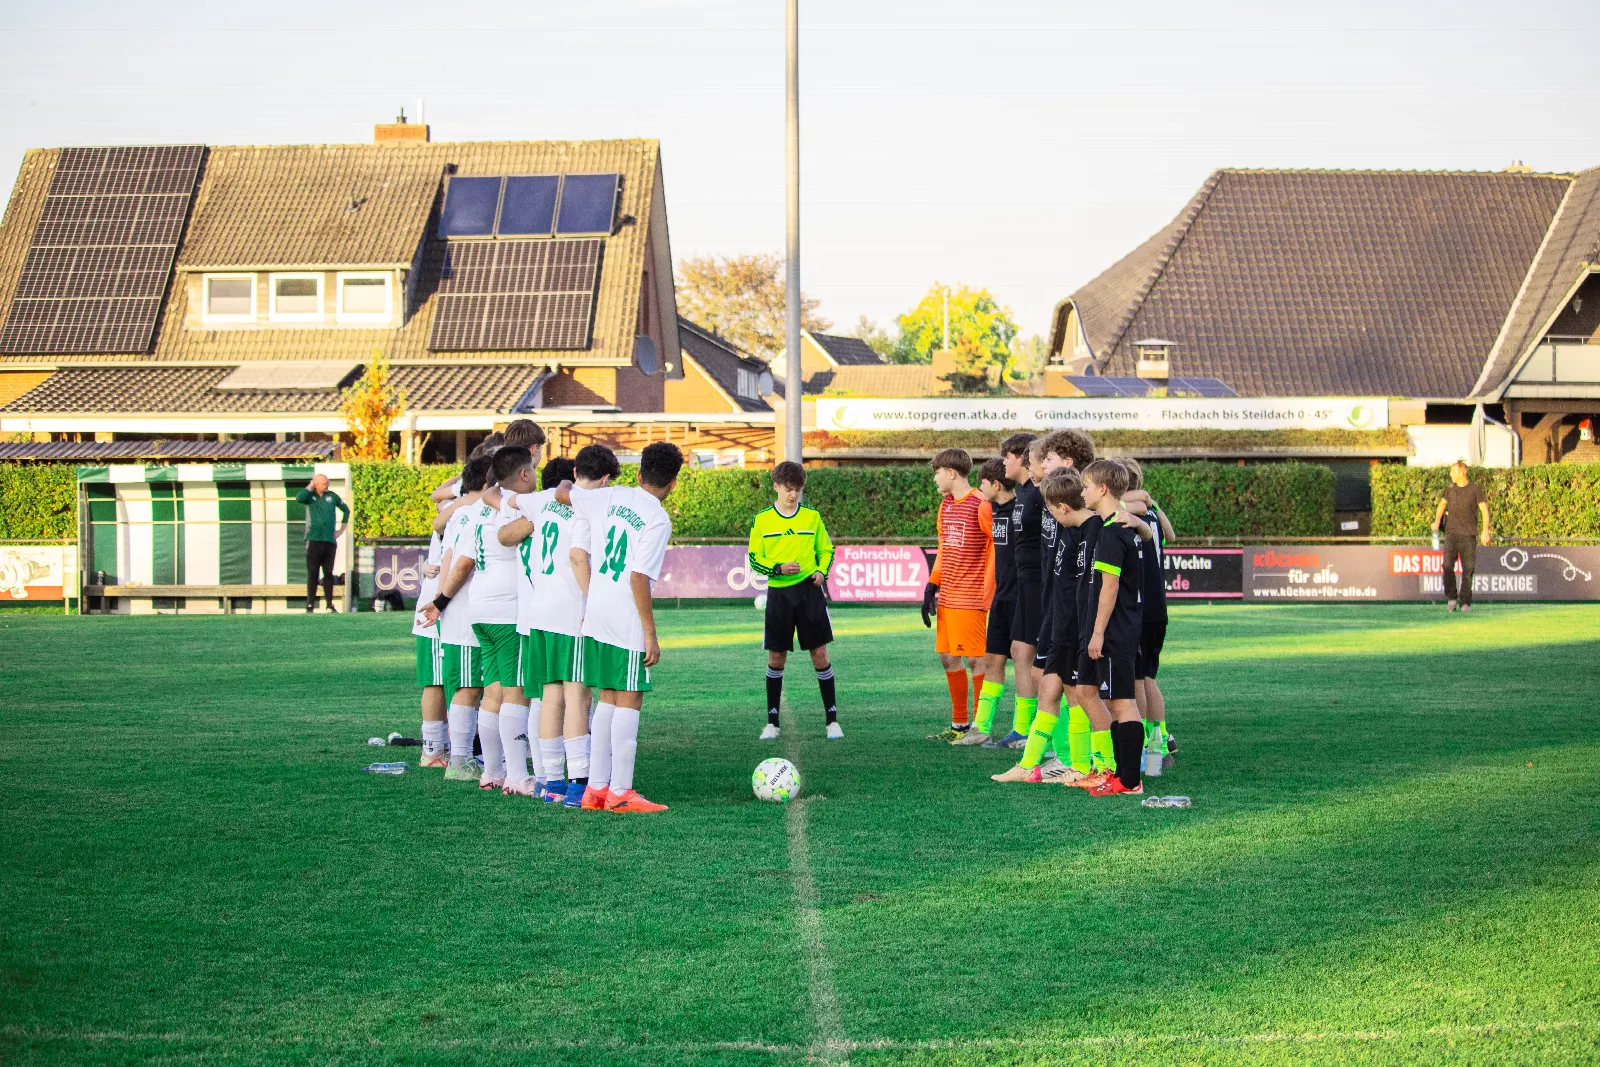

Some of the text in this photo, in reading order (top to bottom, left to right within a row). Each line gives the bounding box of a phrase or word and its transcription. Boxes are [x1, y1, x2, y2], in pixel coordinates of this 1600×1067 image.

[872, 409, 1018, 422] www.topgreen.atka.de
[1034, 410, 1139, 422] Gründachsysteme
[1161, 410, 1220, 420] Flachdach
[1222, 410, 1239, 420] bis
[1242, 410, 1295, 420] Steildach
[1297, 411, 1305, 420] 0
[598, 524, 628, 582] 14
[844, 547, 912, 560] Fahrschule
[1172, 555, 1212, 570] Vechta
[1393, 555, 1421, 573] DAS
[835, 562, 921, 587] SCHULZ
[1287, 567, 1339, 584] für alle
[1252, 586, 1377, 597] www.küchen-für-alle.de
[1423, 575, 1445, 592] MU
[1491, 575, 1533, 592] ECKIGE
